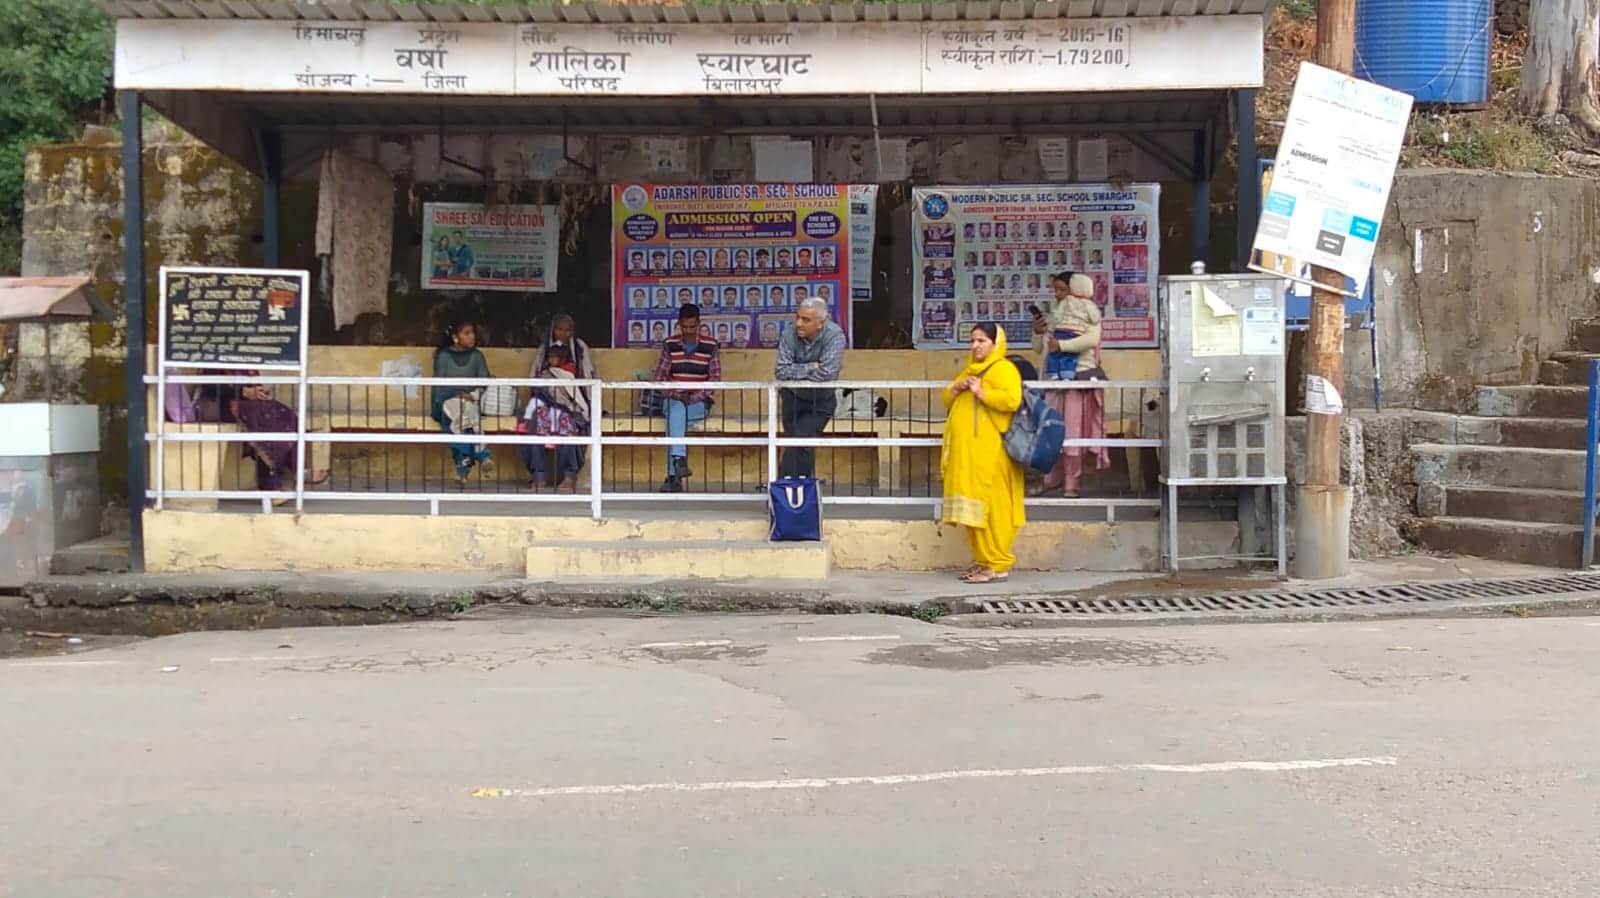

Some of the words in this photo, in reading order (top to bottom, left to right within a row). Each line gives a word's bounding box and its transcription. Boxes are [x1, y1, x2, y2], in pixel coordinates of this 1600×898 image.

[1060, 27, 1123, 43] 2015-16
[394, 44, 448, 69] वर्षा
[529, 46, 632, 72] शालिका
[420, 71, 468, 89] जिला
[654, 186, 698, 200] ADARSH
[701, 186, 740, 199] PUBLIC
[794, 184, 839, 197] SCHOOL
[952, 193, 986, 203] MODERN
[989, 193, 1018, 202] PUBLIC
[1057, 192, 1090, 202] SCHOOL
[668, 213, 750, 225] ADMISSION
[753, 212, 793, 224] OPEN
